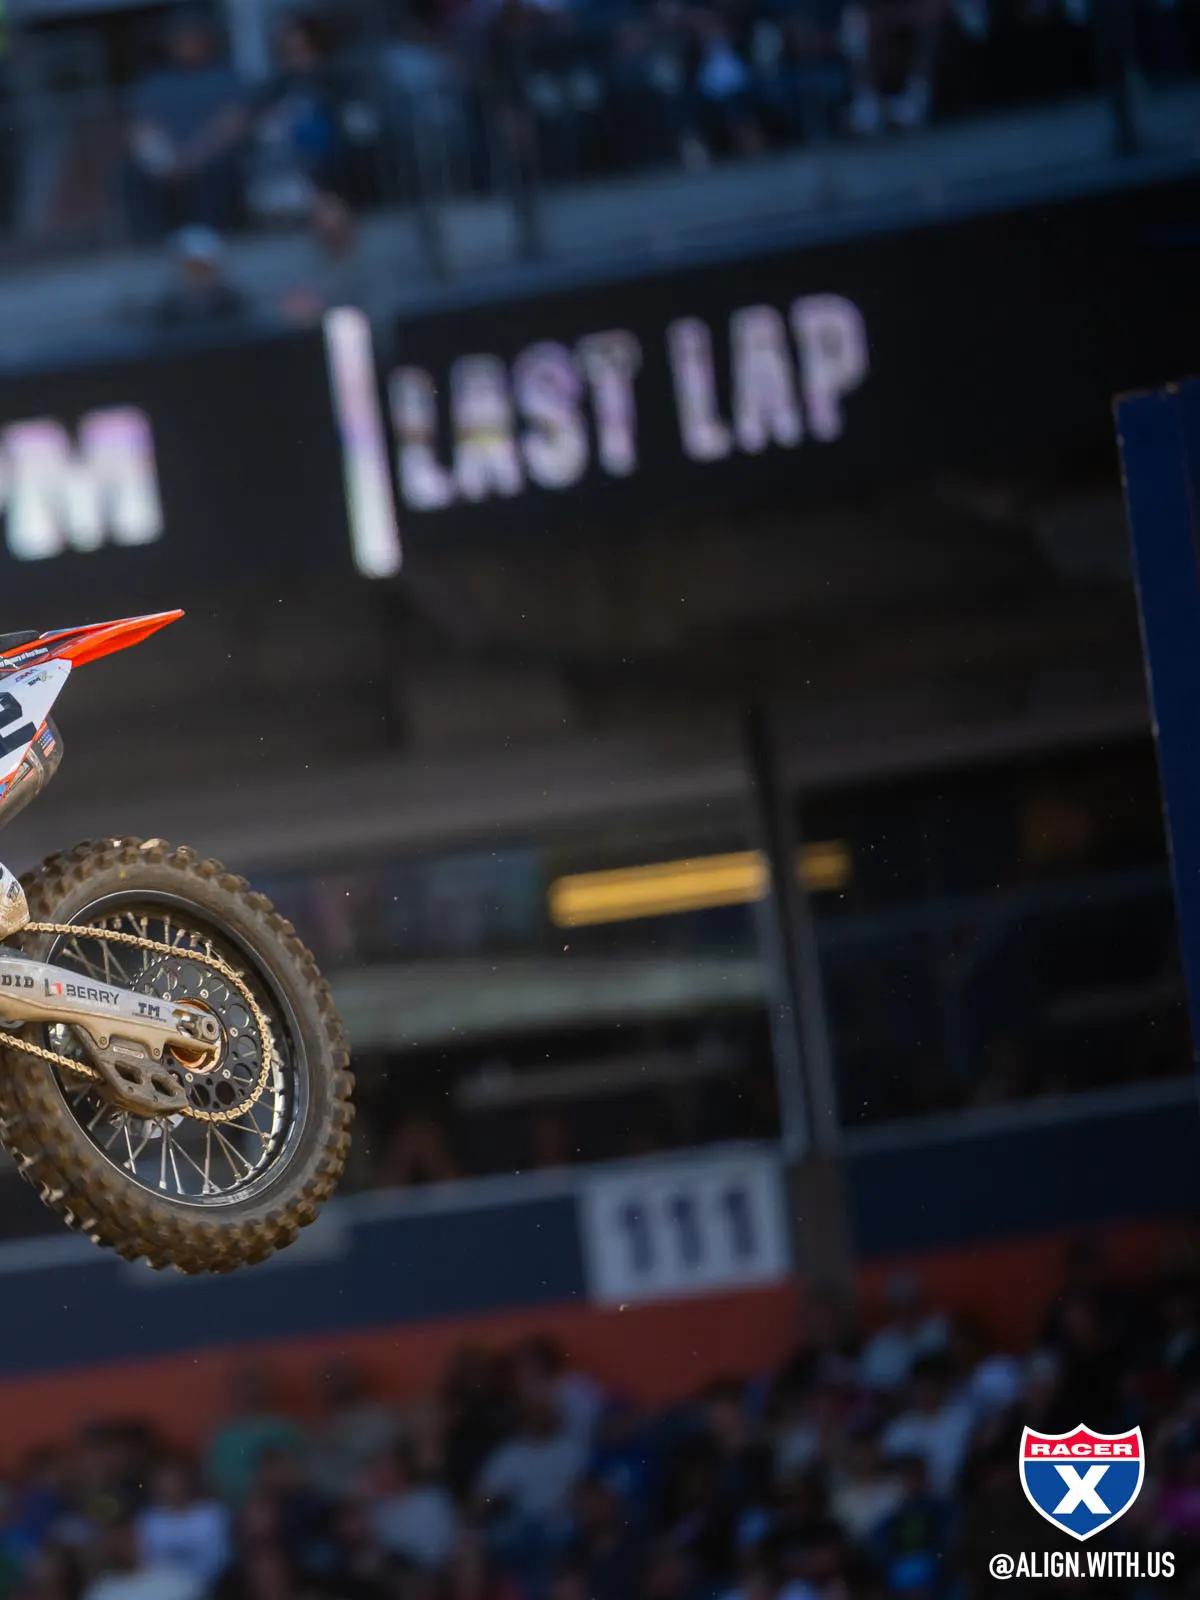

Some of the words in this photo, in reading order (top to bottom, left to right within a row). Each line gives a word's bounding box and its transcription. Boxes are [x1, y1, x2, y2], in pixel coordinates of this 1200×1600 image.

[390, 327, 642, 510] LAST
[668, 292, 869, 463] LAP
[65, 982, 121, 1005] BERRY
